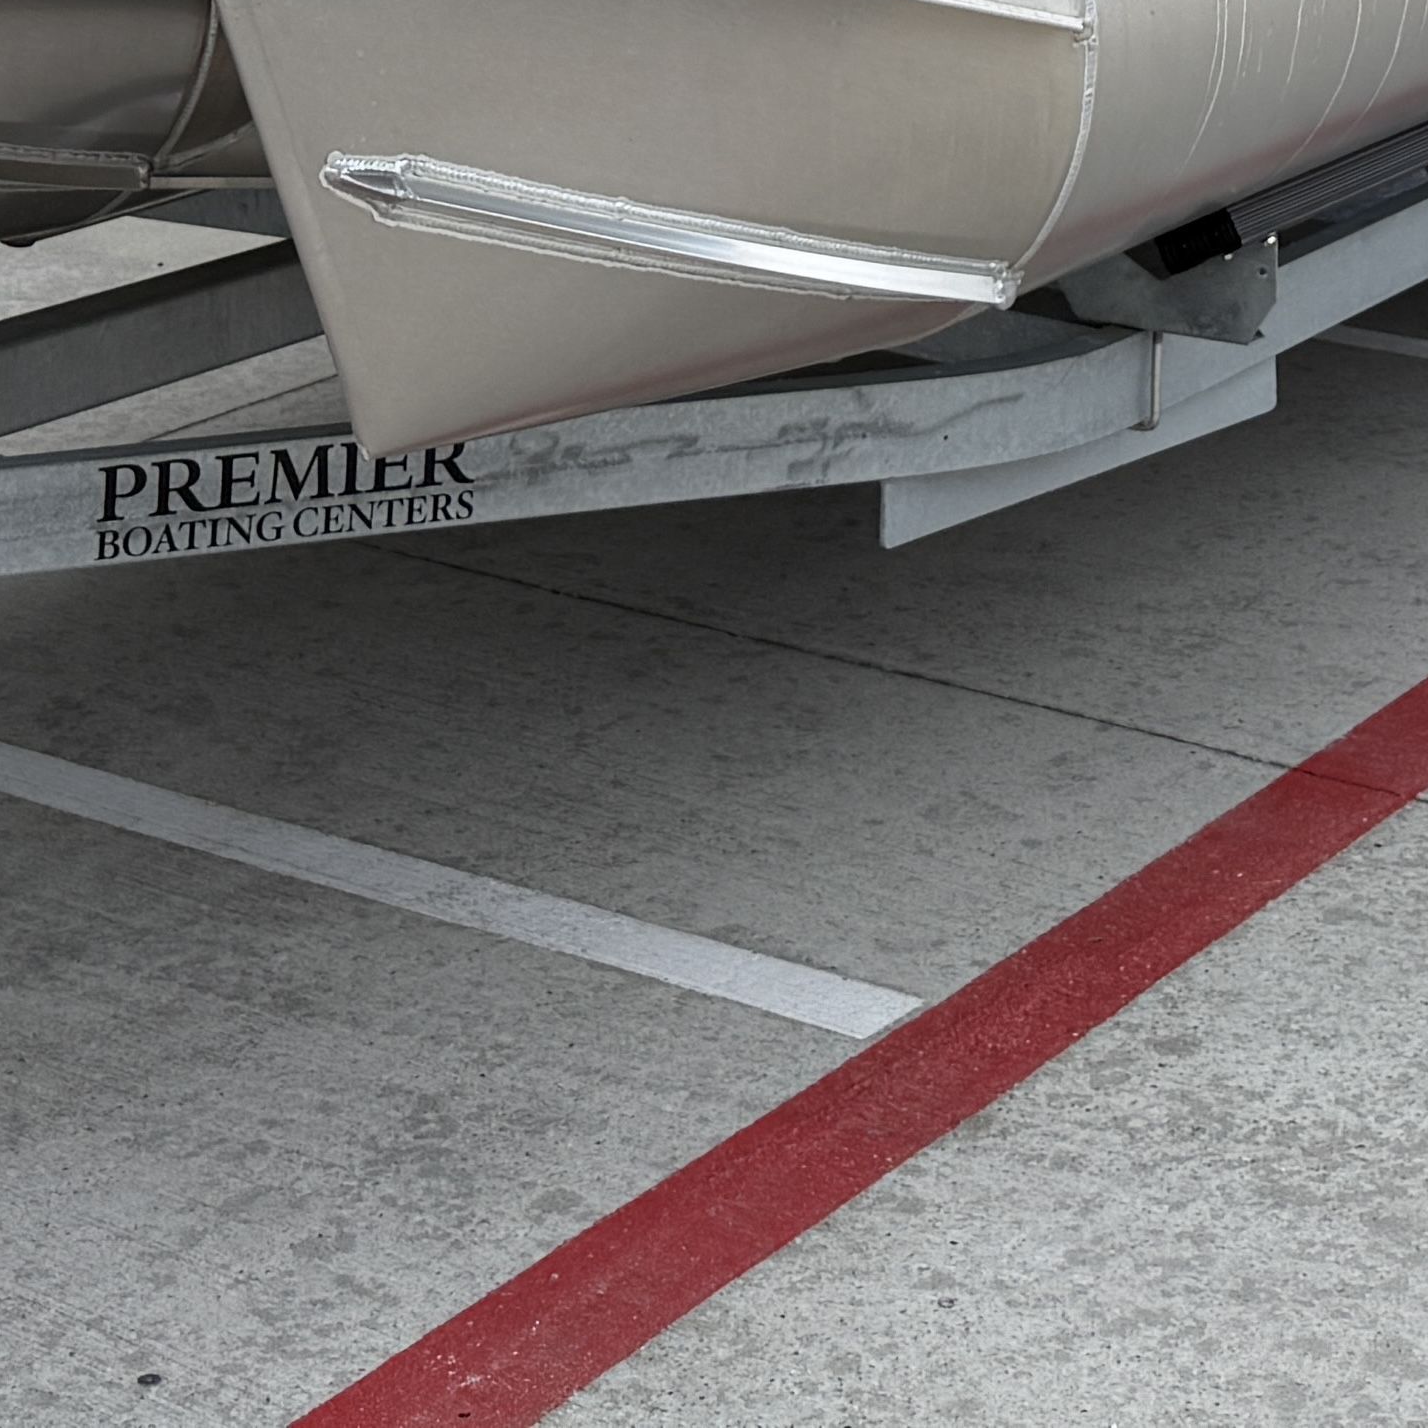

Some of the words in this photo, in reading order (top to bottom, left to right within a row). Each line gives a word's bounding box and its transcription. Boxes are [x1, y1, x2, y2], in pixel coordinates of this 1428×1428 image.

[96, 441, 475, 523] PREMIER
[94, 509, 283, 562] BOATING
[293, 489, 474, 541] CENTERS
